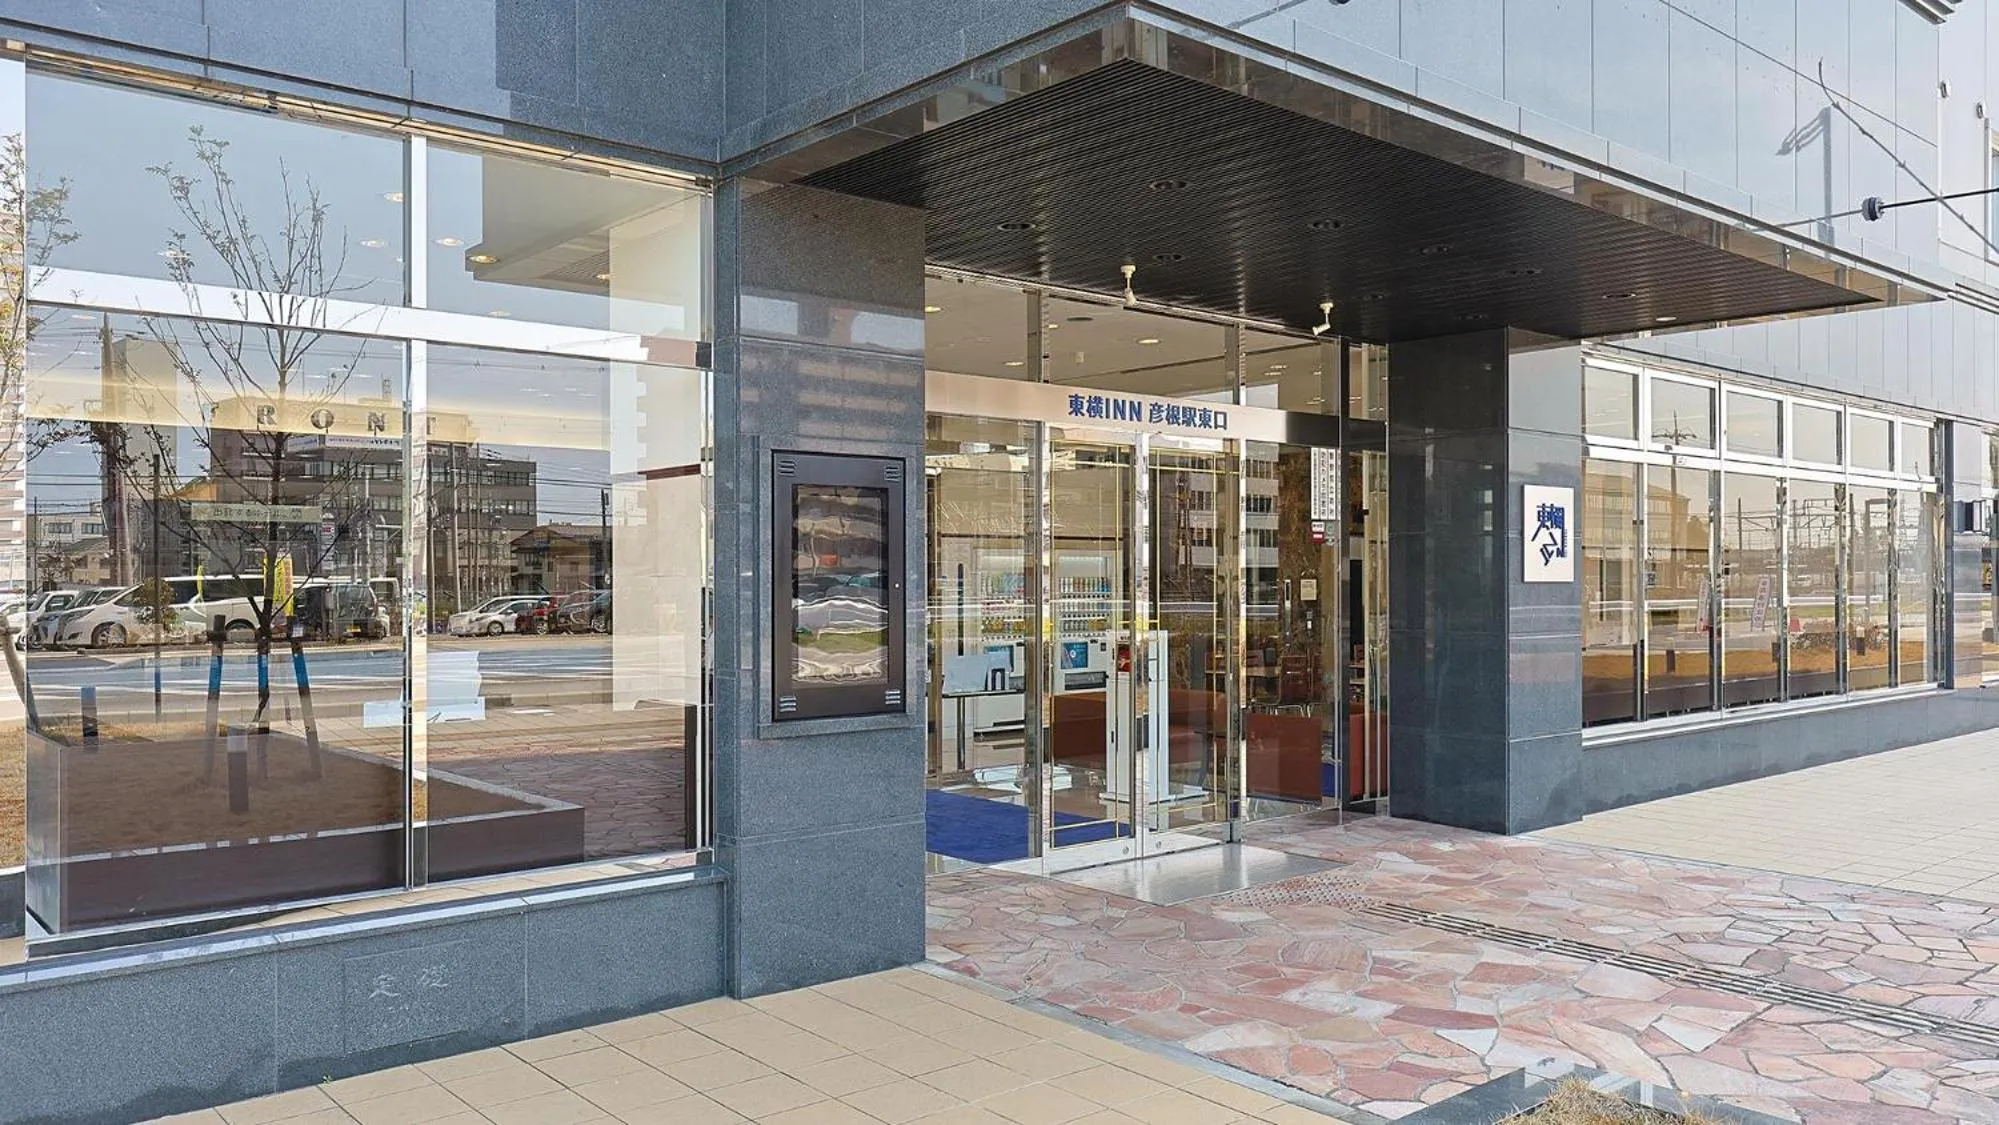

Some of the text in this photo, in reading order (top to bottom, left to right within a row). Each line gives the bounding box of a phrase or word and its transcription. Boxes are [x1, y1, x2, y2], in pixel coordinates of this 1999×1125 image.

[1068, 394, 1228, 431] 東横INN 彦根駅東口
